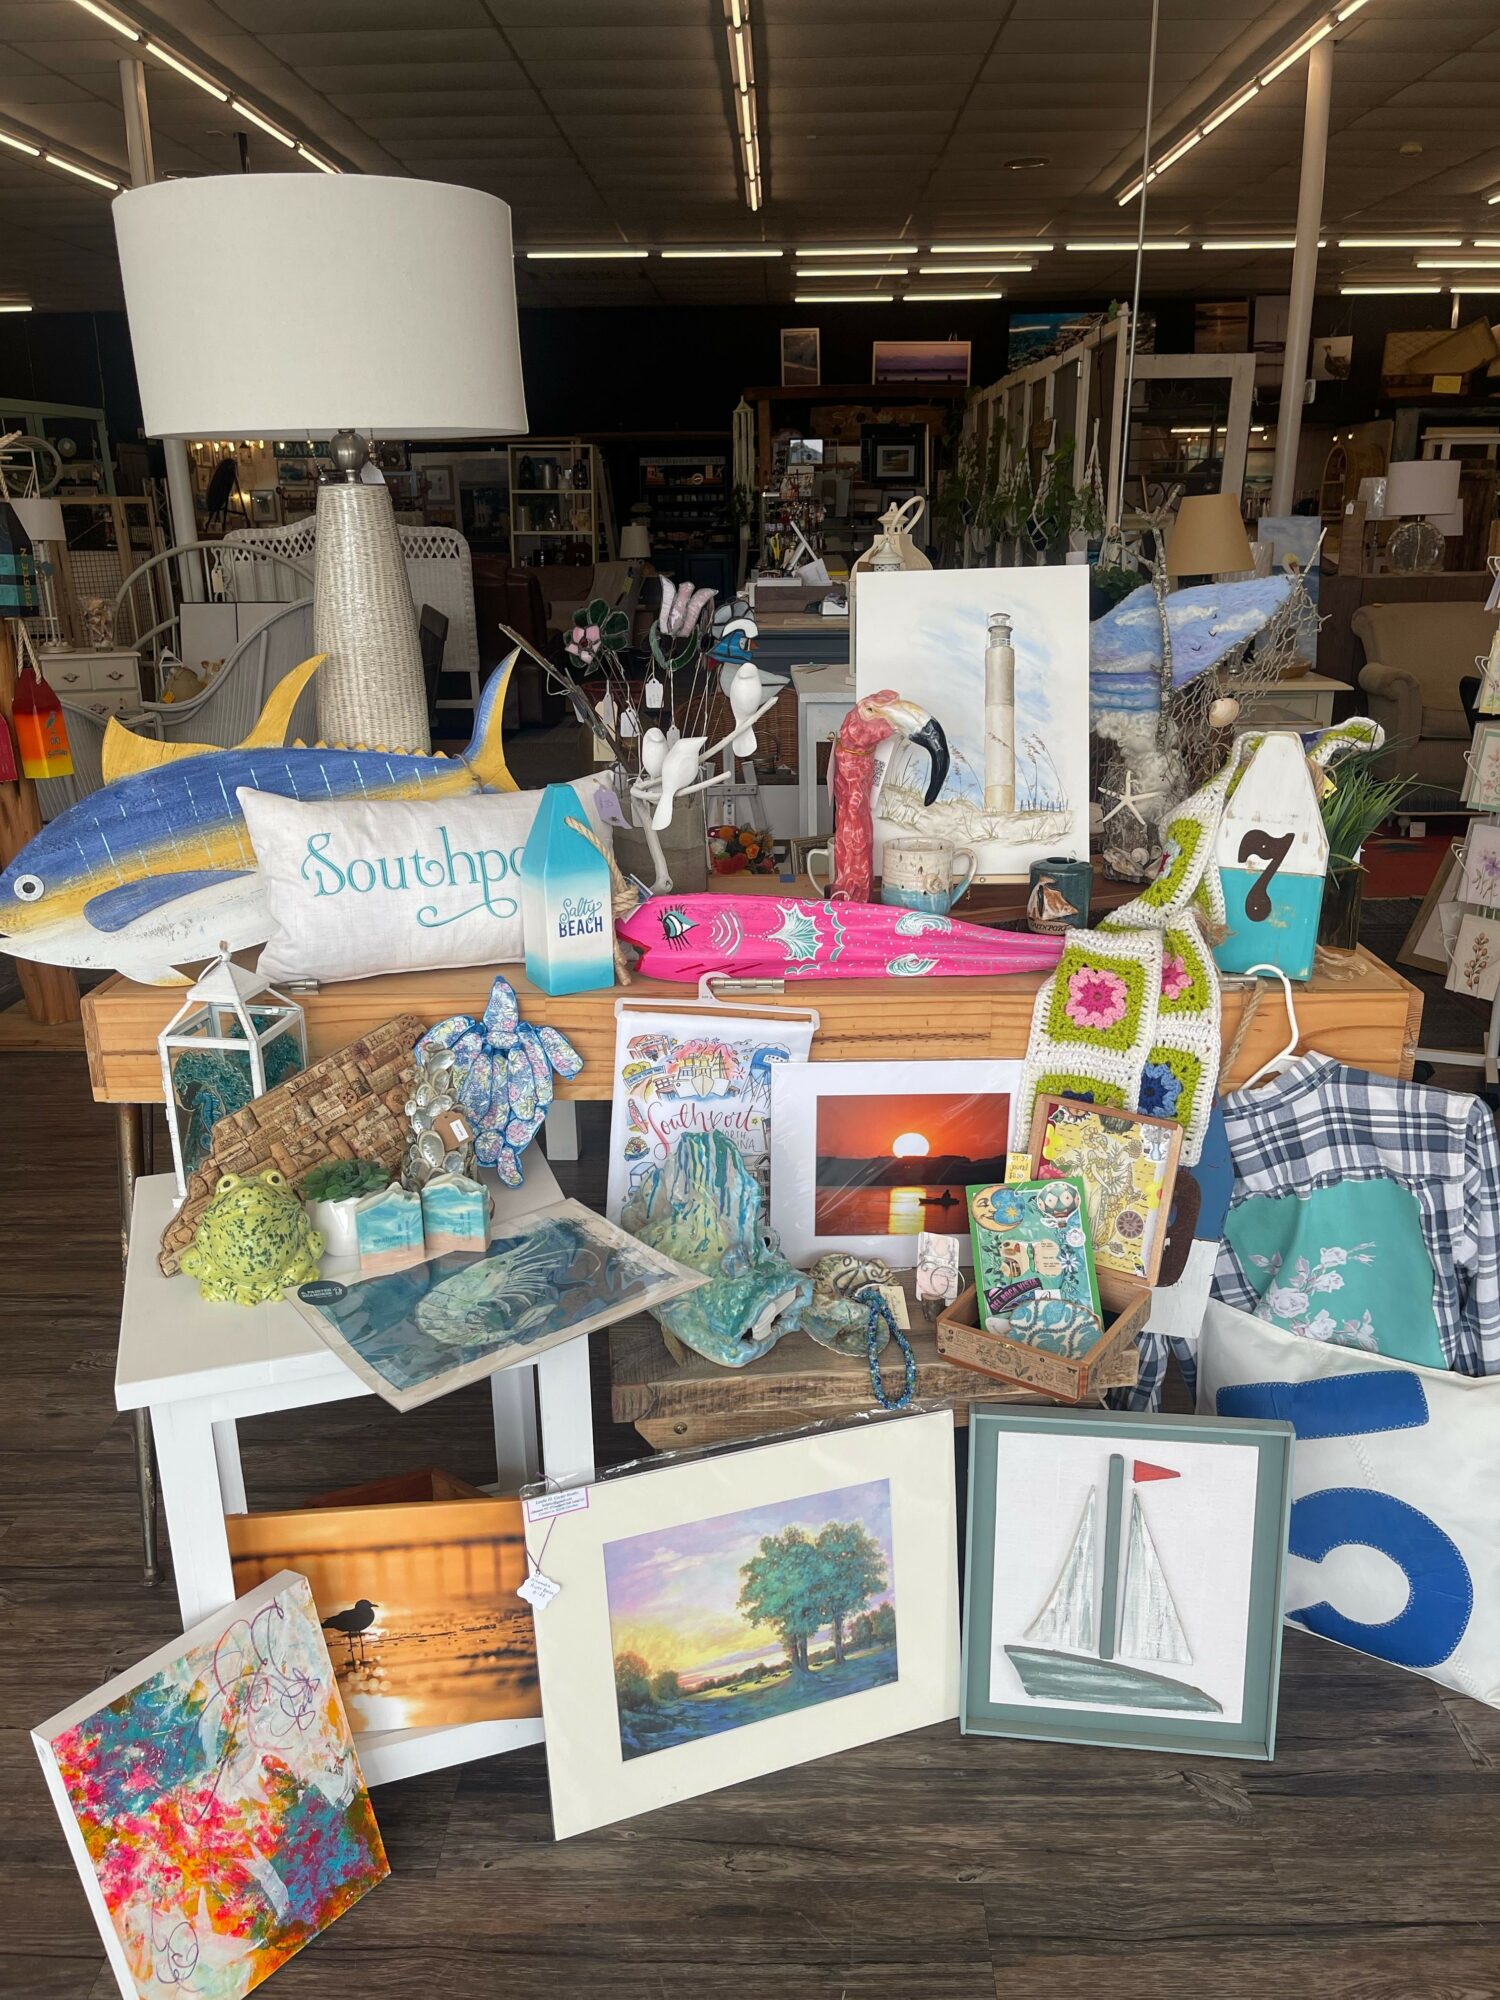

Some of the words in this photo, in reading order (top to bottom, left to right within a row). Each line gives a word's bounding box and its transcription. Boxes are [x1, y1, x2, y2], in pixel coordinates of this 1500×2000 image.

[1237, 828, 1295, 923] 7
[559, 897, 602, 927] Salty
[559, 916, 603, 938] BEACH
[648, 1101, 764, 1160] Southport
